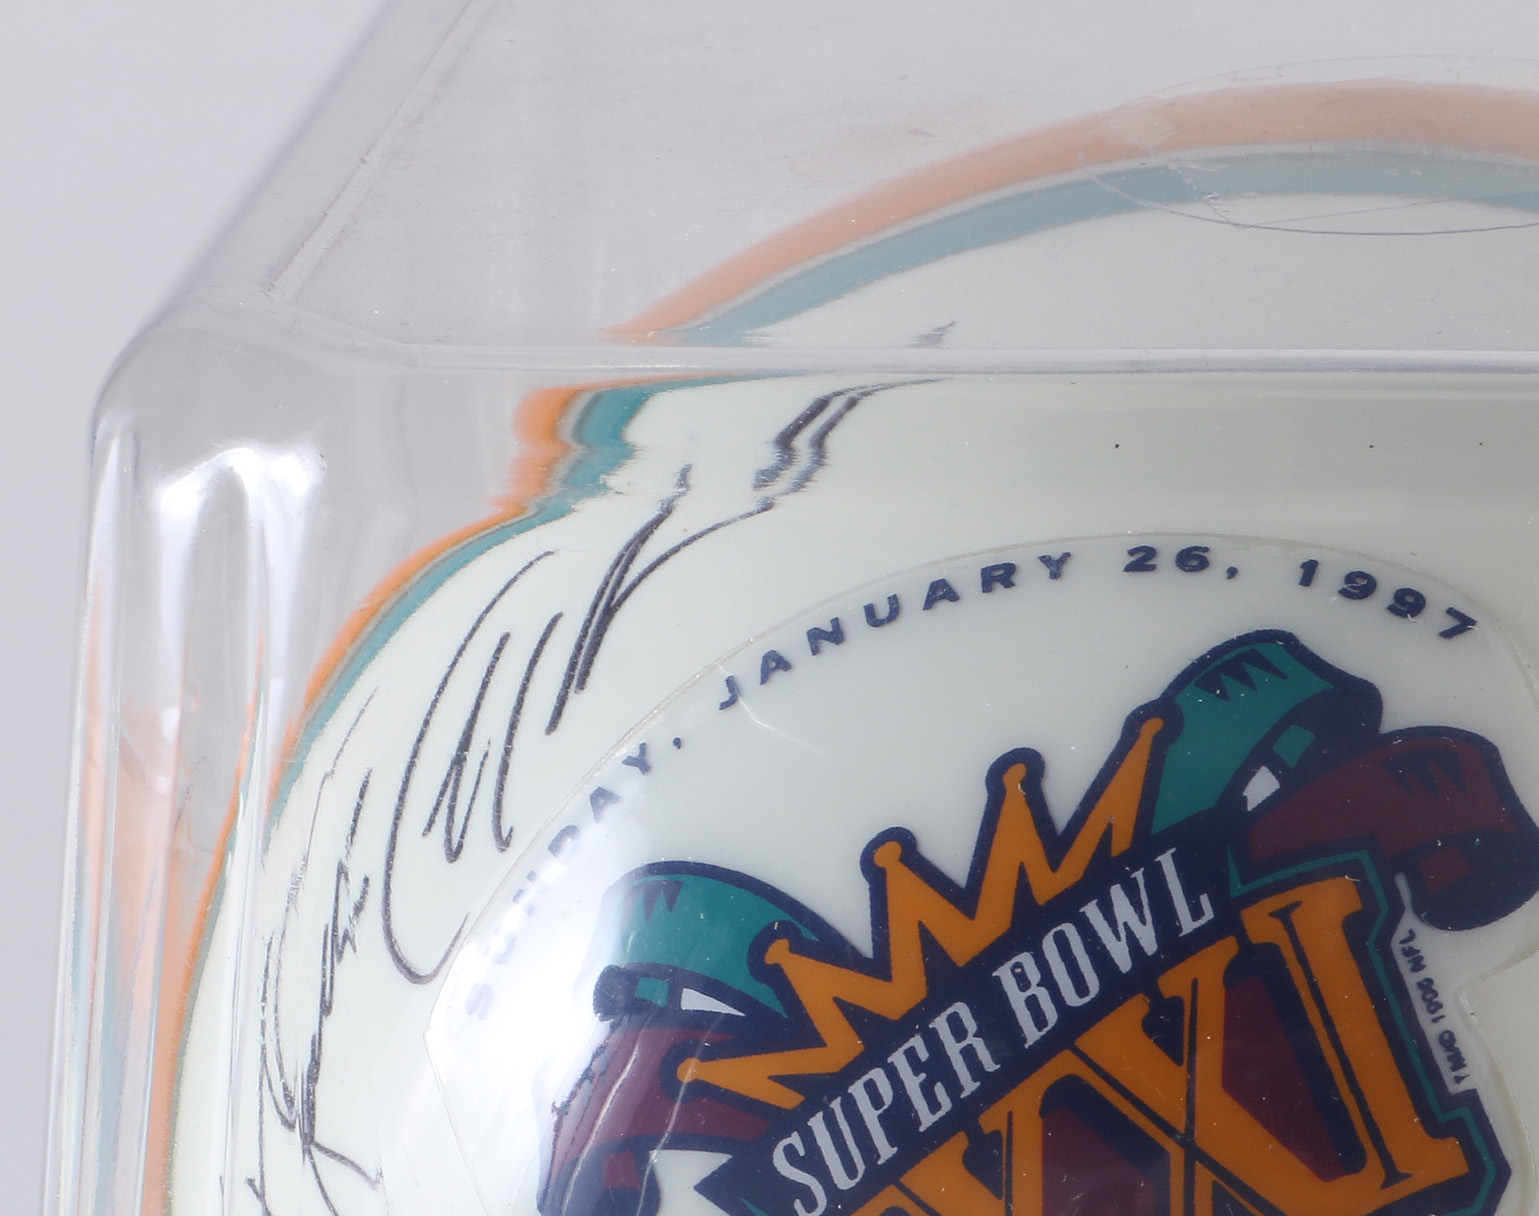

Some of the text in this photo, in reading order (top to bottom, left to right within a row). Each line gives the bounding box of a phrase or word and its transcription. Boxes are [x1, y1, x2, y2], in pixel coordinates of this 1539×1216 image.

[718, 550, 1071, 711] JANUARY
[1122, 545, 1239, 580] 26,
[1298, 558, 1477, 640] 1997
[991, 847, 1214, 1048] BOWL
[1398, 927, 1427, 974] NFL
